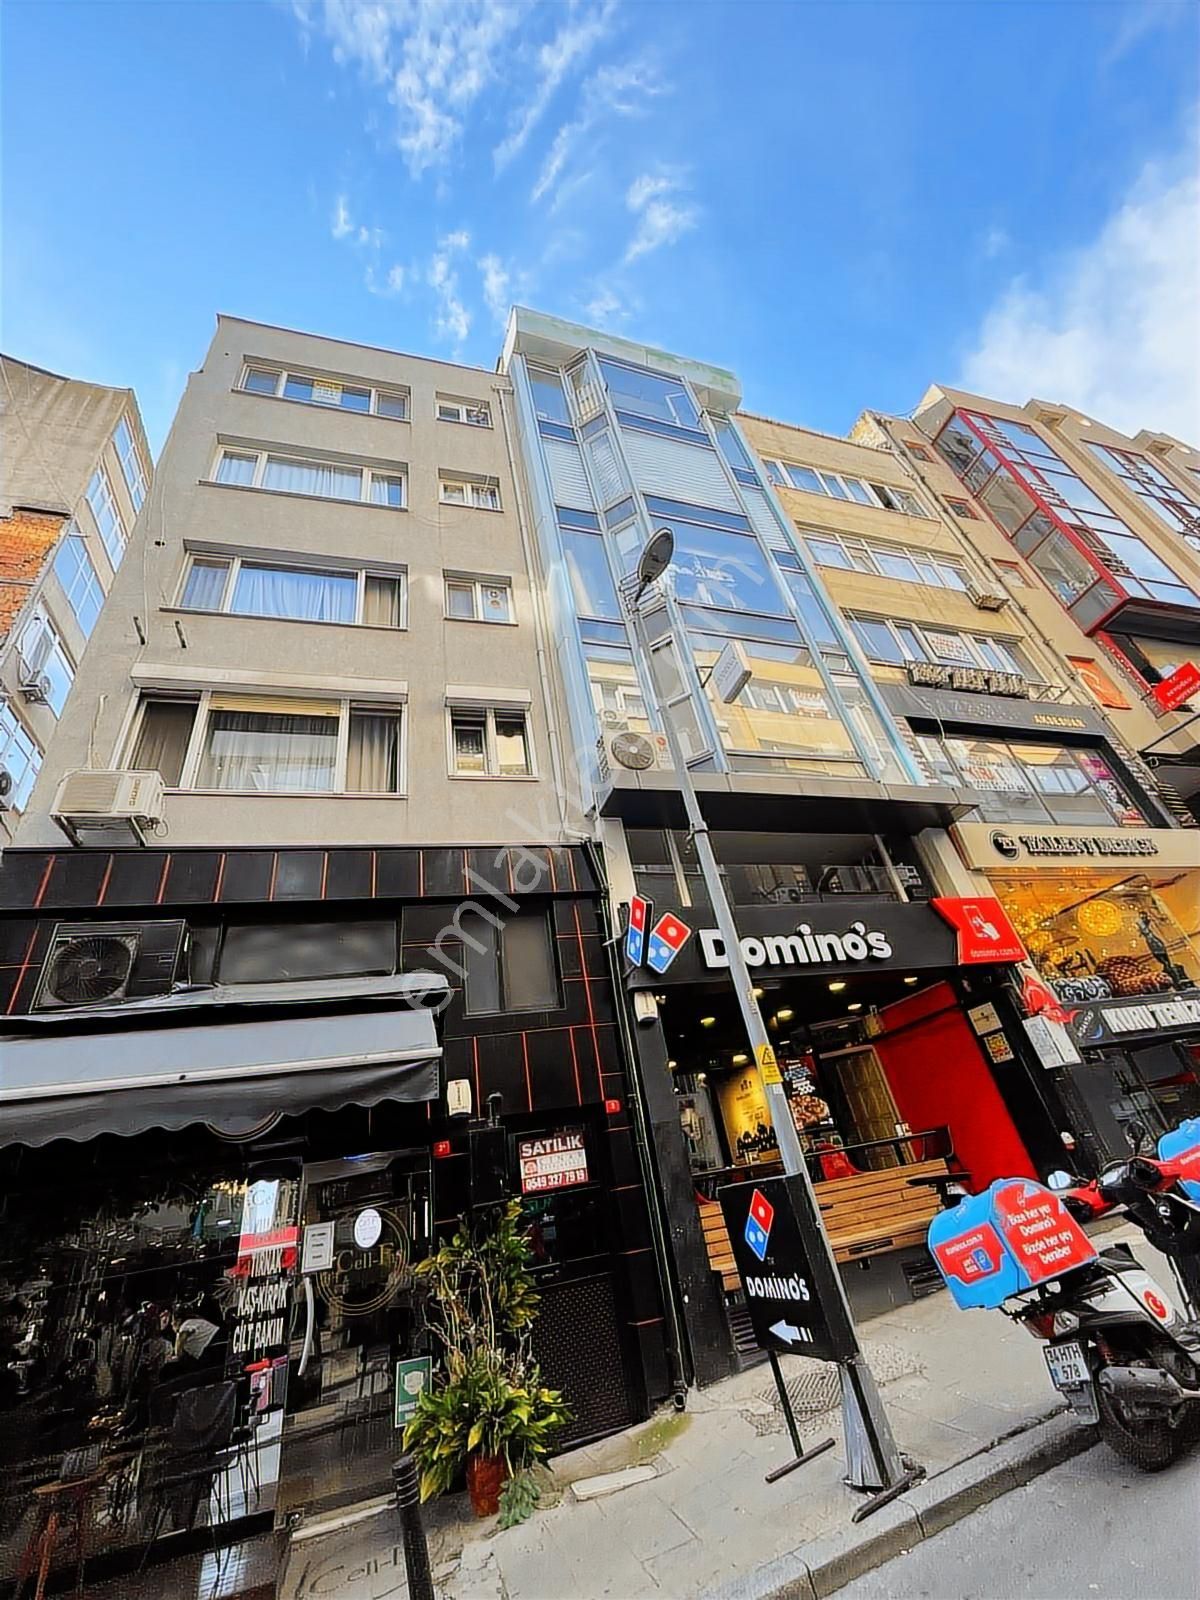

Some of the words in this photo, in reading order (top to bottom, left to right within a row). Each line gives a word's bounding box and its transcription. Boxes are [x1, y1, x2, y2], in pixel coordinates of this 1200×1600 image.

[699, 921, 893, 968] Domino's
[1100, 1004, 1157, 1033] KURU
[522, 1135, 582, 1157] SATILIK
[1025, 1206, 1041, 1222] her
[1039, 1203, 1053, 1219] yer
[1019, 1216, 1056, 1237] Domino's
[1022, 1239, 1046, 1256] Bizde
[1044, 1234, 1060, 1249] her
[1038, 1244, 1072, 1265] beraber
[250, 1248, 283, 1278] TIRNAK
[254, 1318, 284, 1349] BAKIM
